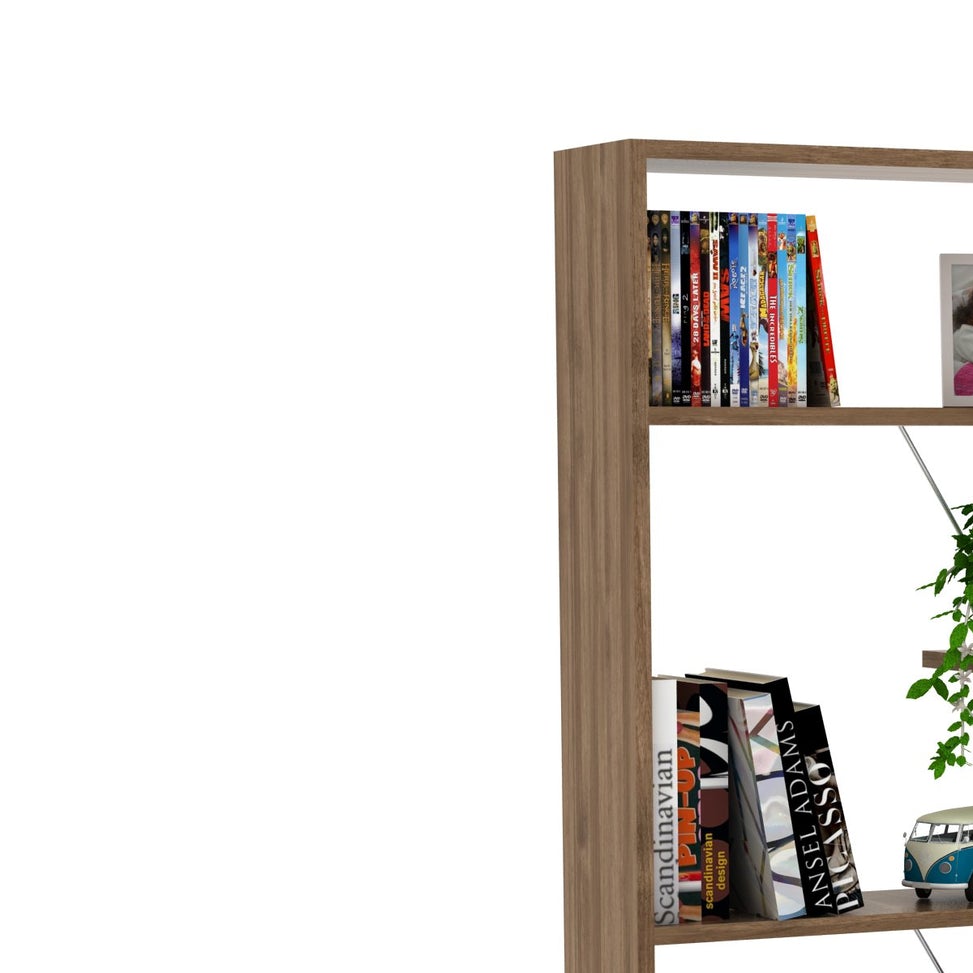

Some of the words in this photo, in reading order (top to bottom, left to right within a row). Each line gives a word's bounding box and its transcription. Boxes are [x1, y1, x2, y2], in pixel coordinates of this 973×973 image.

[692, 329, 699, 343] 28
[720, 268, 730, 323] SAW
[677, 746, 697, 867] PIN-UP
[776, 720, 812, 815] ADAMS
[654, 748, 674, 925] Scandinavian
[699, 832, 713, 910] scandinavian
[716, 850, 728, 890] design
[800, 825, 833, 910] ANSEL
[809, 762, 859, 914] PICASSO
